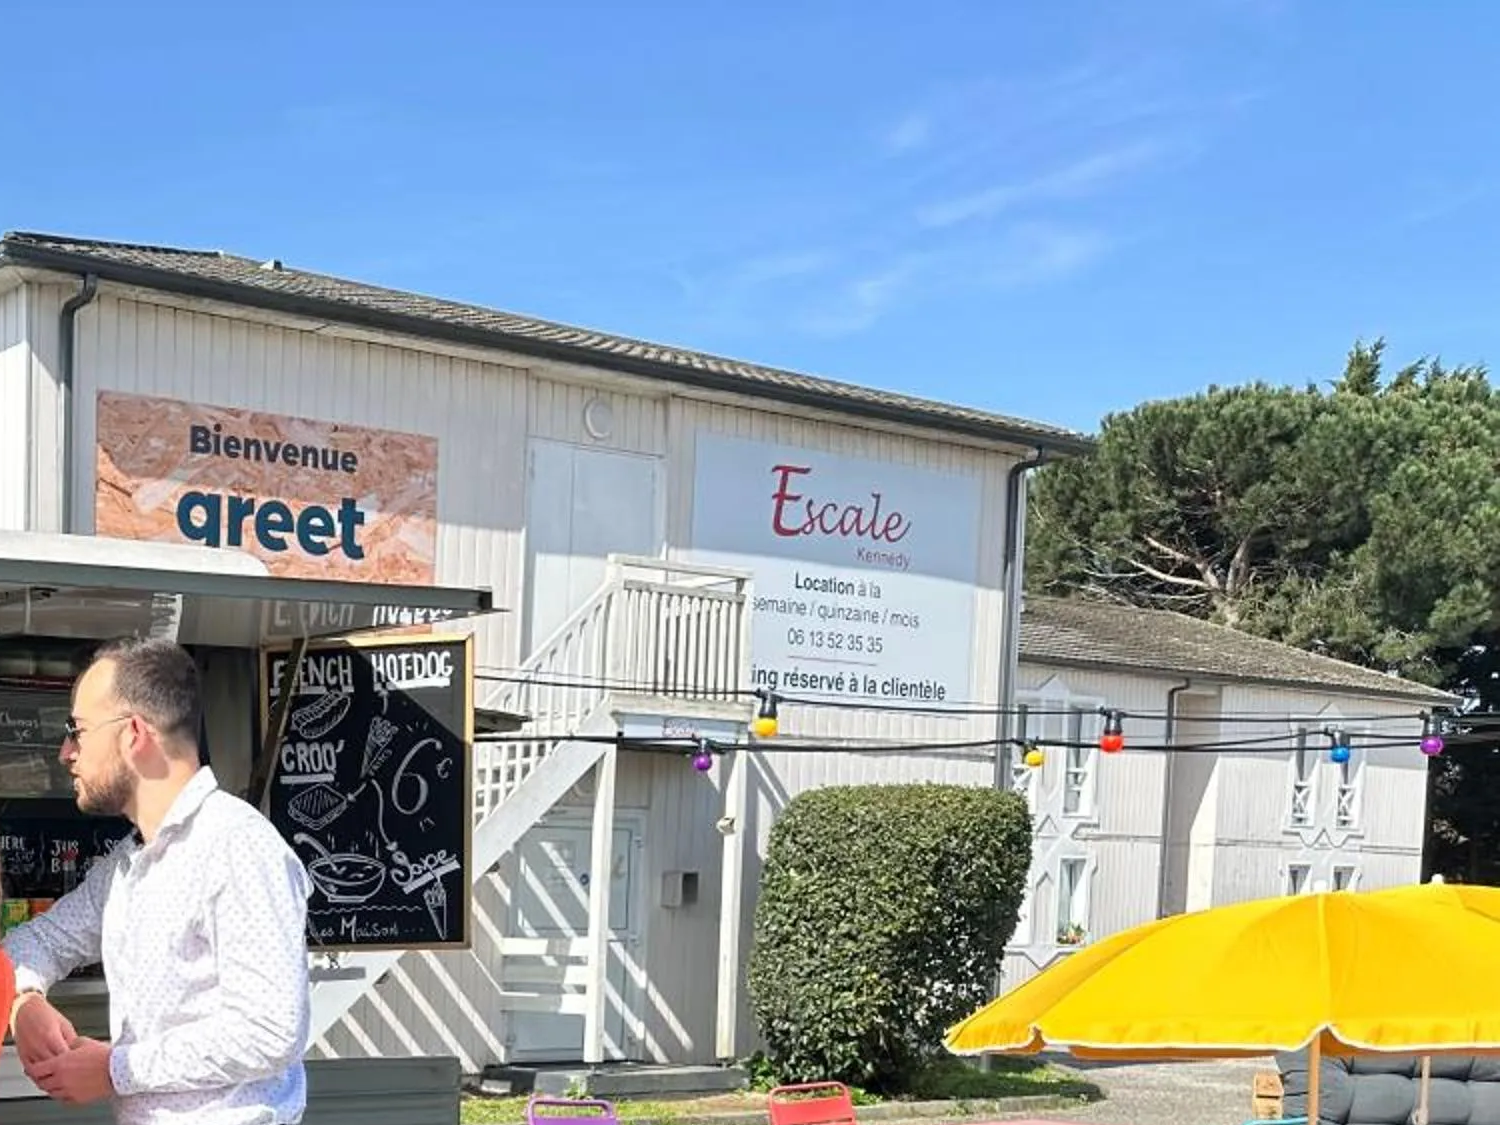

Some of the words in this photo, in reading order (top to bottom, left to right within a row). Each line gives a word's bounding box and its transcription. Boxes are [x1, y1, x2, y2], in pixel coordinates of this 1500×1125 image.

[190, 424, 358, 474] Bienvenue
[771, 465, 912, 543] Escale
[857, 547, 911, 570] Kennedy
[795, 572, 854, 595] Location
[869, 582, 882, 599] la
[818, 604, 879, 624] quinzaine
[889, 612, 920, 629] mois
[273, 655, 352, 688] FENCH
[751, 664, 778, 690] ing
[783, 666, 844, 692] réservé
[850, 672, 858, 692] à
[864, 674, 877, 694] la
[881, 677, 946, 700] clientèle
